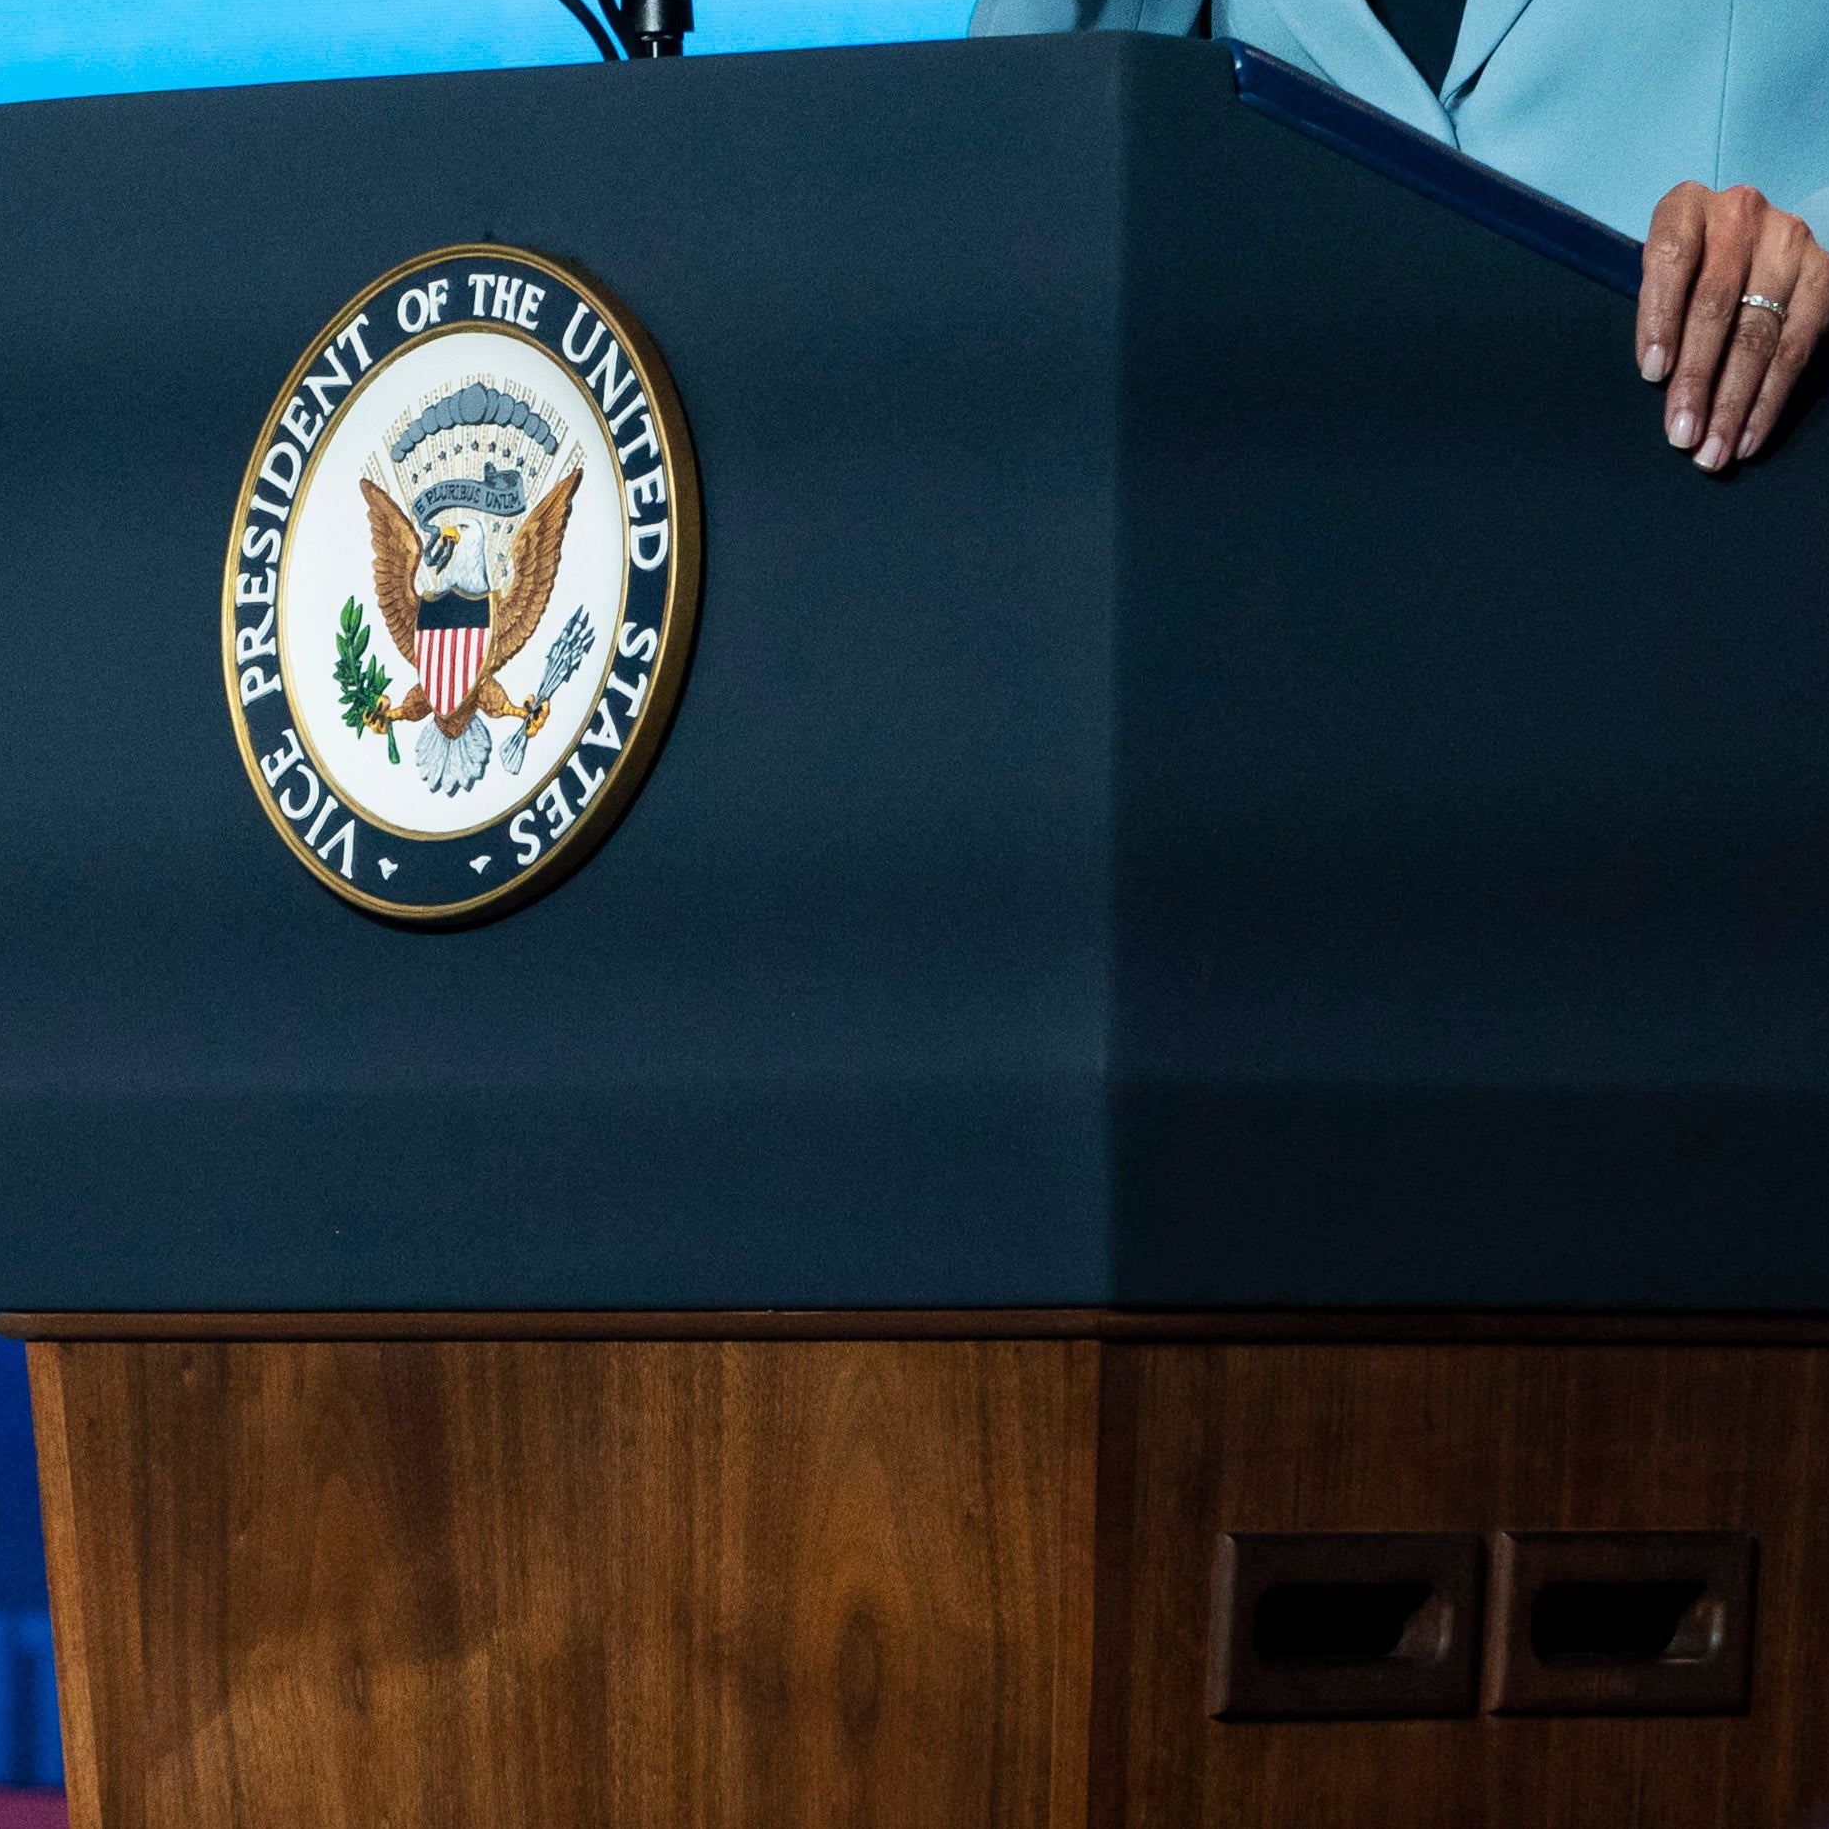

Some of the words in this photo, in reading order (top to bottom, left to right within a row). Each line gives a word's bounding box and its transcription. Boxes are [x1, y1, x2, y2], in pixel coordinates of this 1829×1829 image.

[396, 277, 450, 334] OF
[467, 272, 547, 332] THE
[235, 313, 373, 707] PRESIDENT
[414, 498, 426, 515] E
[425, 484, 481, 506] PLURIBUS
[561, 301, 670, 572] UNITED
[259, 728, 357, 881] VICE
[509, 621, 659, 867] STATES
